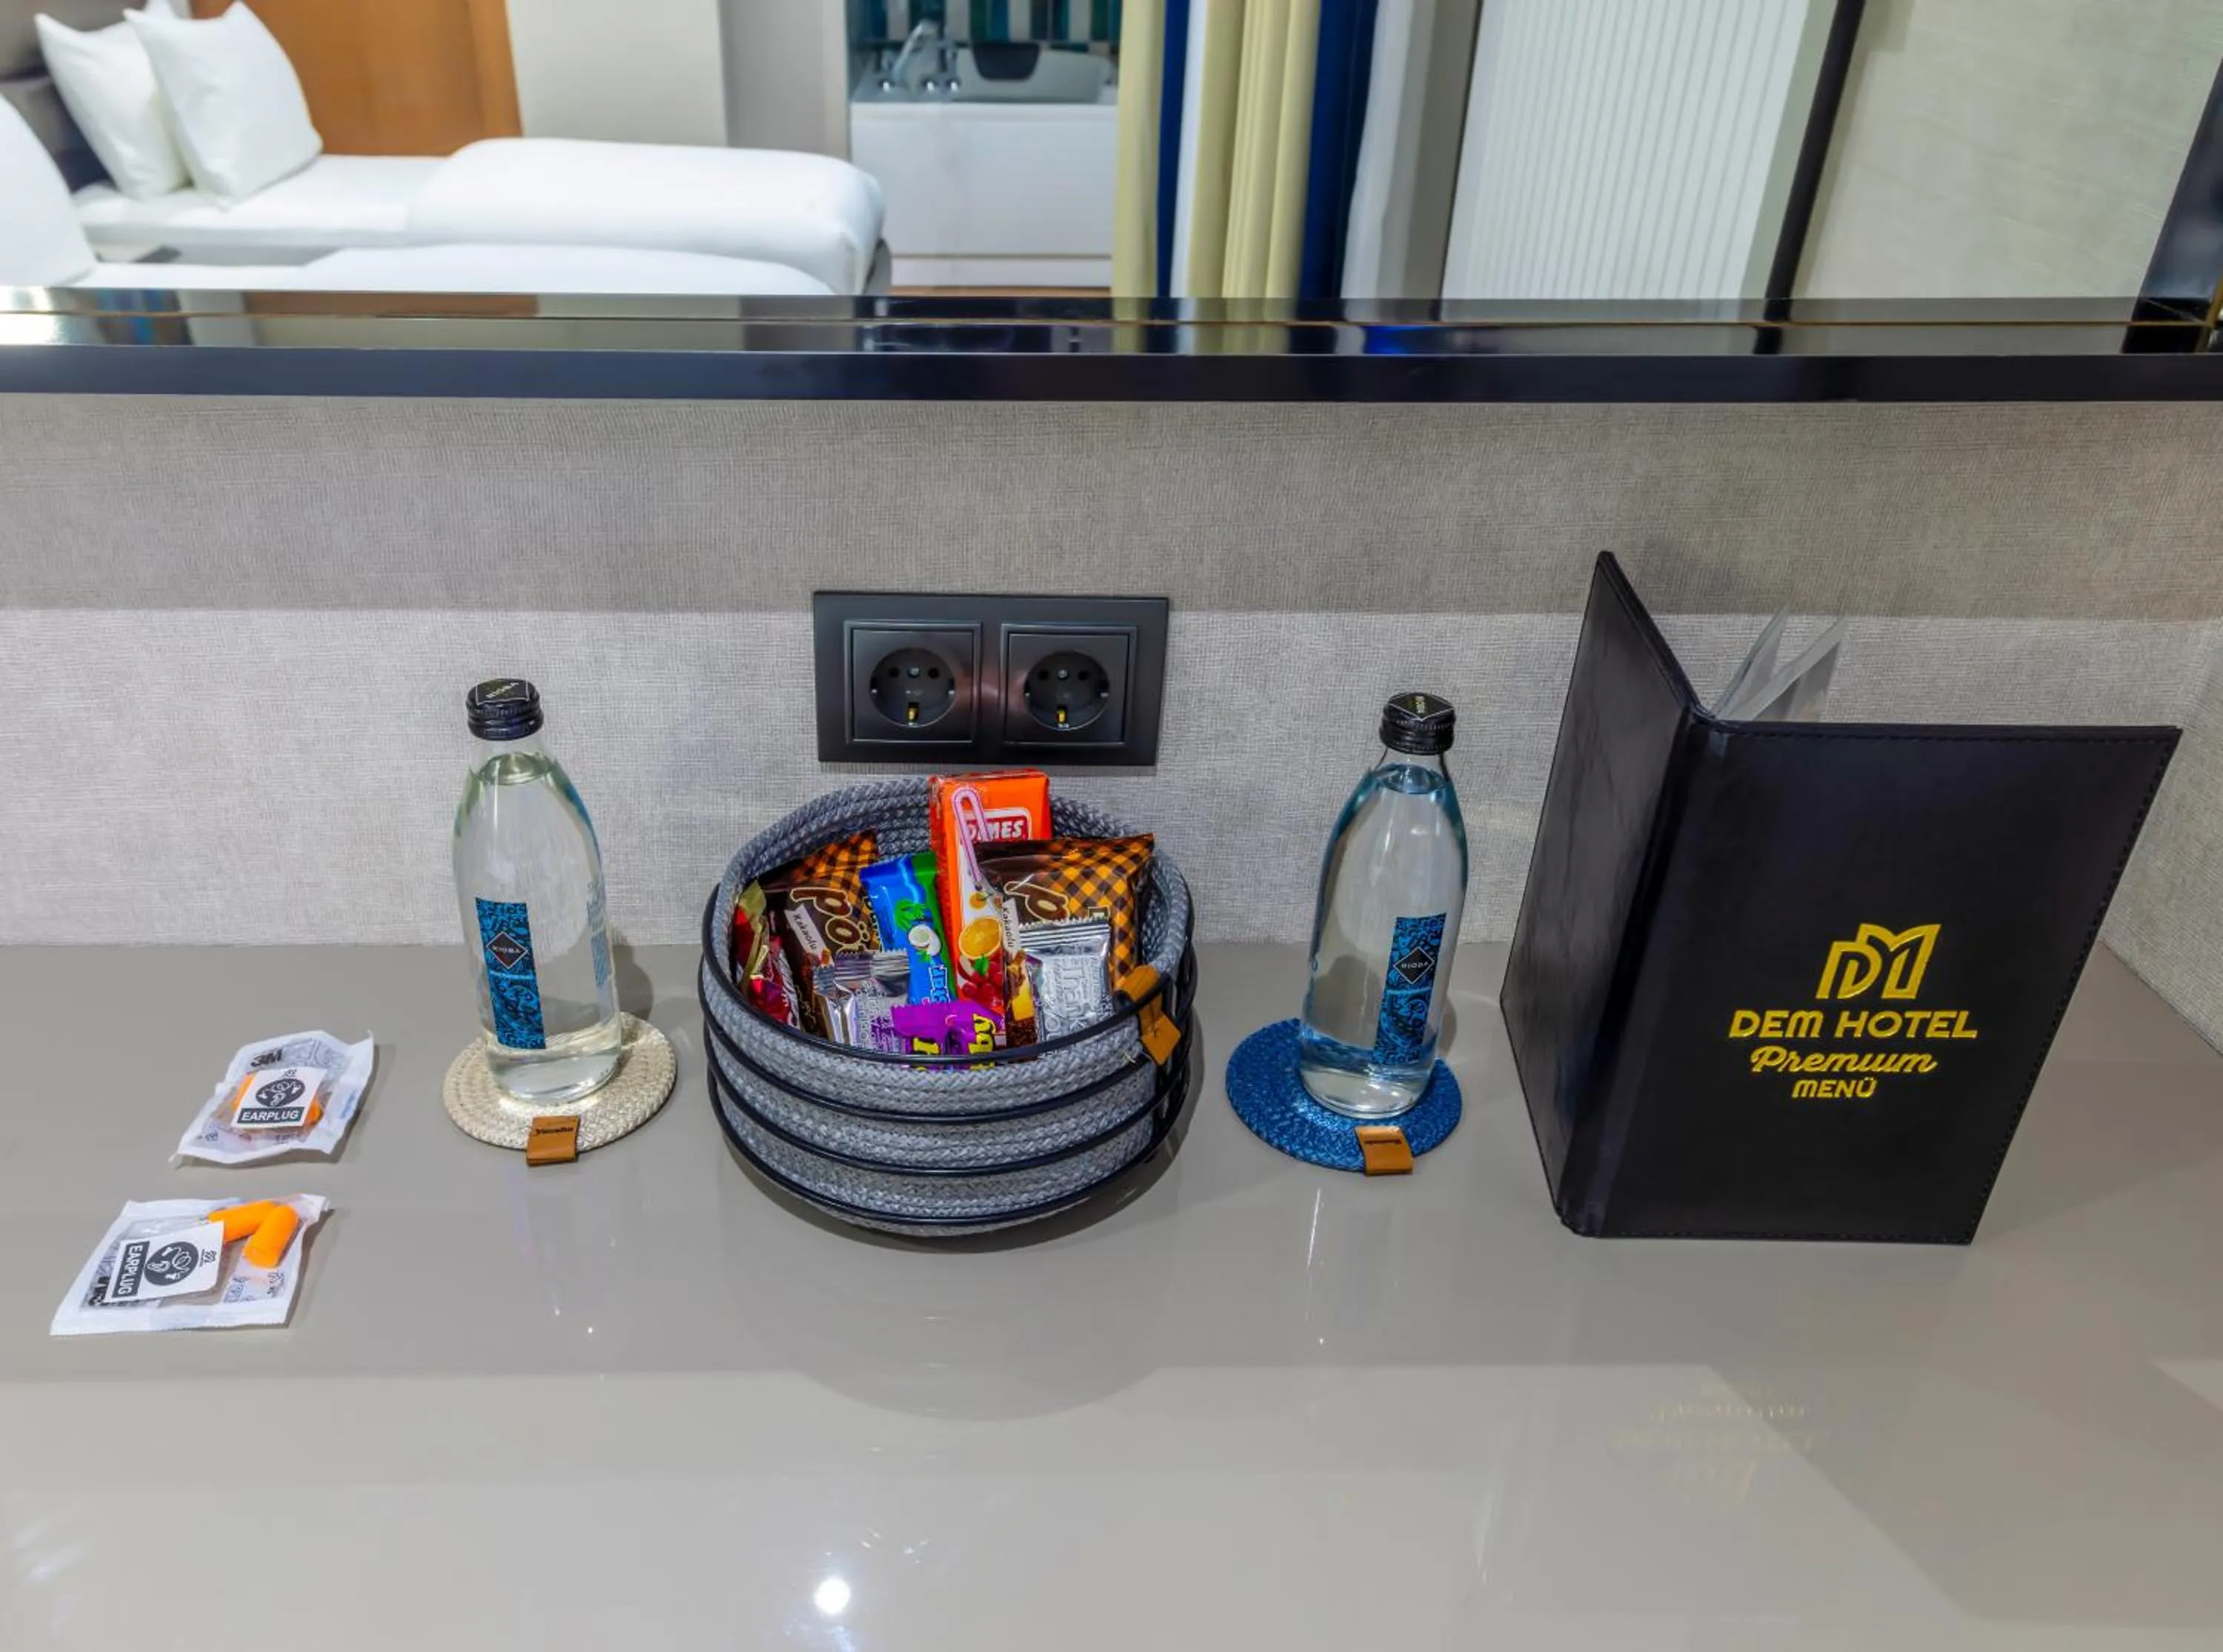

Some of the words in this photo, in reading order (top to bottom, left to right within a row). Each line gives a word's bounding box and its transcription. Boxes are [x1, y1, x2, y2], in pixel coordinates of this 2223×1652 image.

[1729, 1010, 1824, 1039] DEM
[1833, 1010, 1978, 1039] HOTEL
[1750, 1045, 1938, 1074] Premium
[1791, 1076, 1878, 1099] MENÜ
[241, 1110, 299, 1121] EARPLUG
[118, 1244, 144, 1296] EARPLUG
